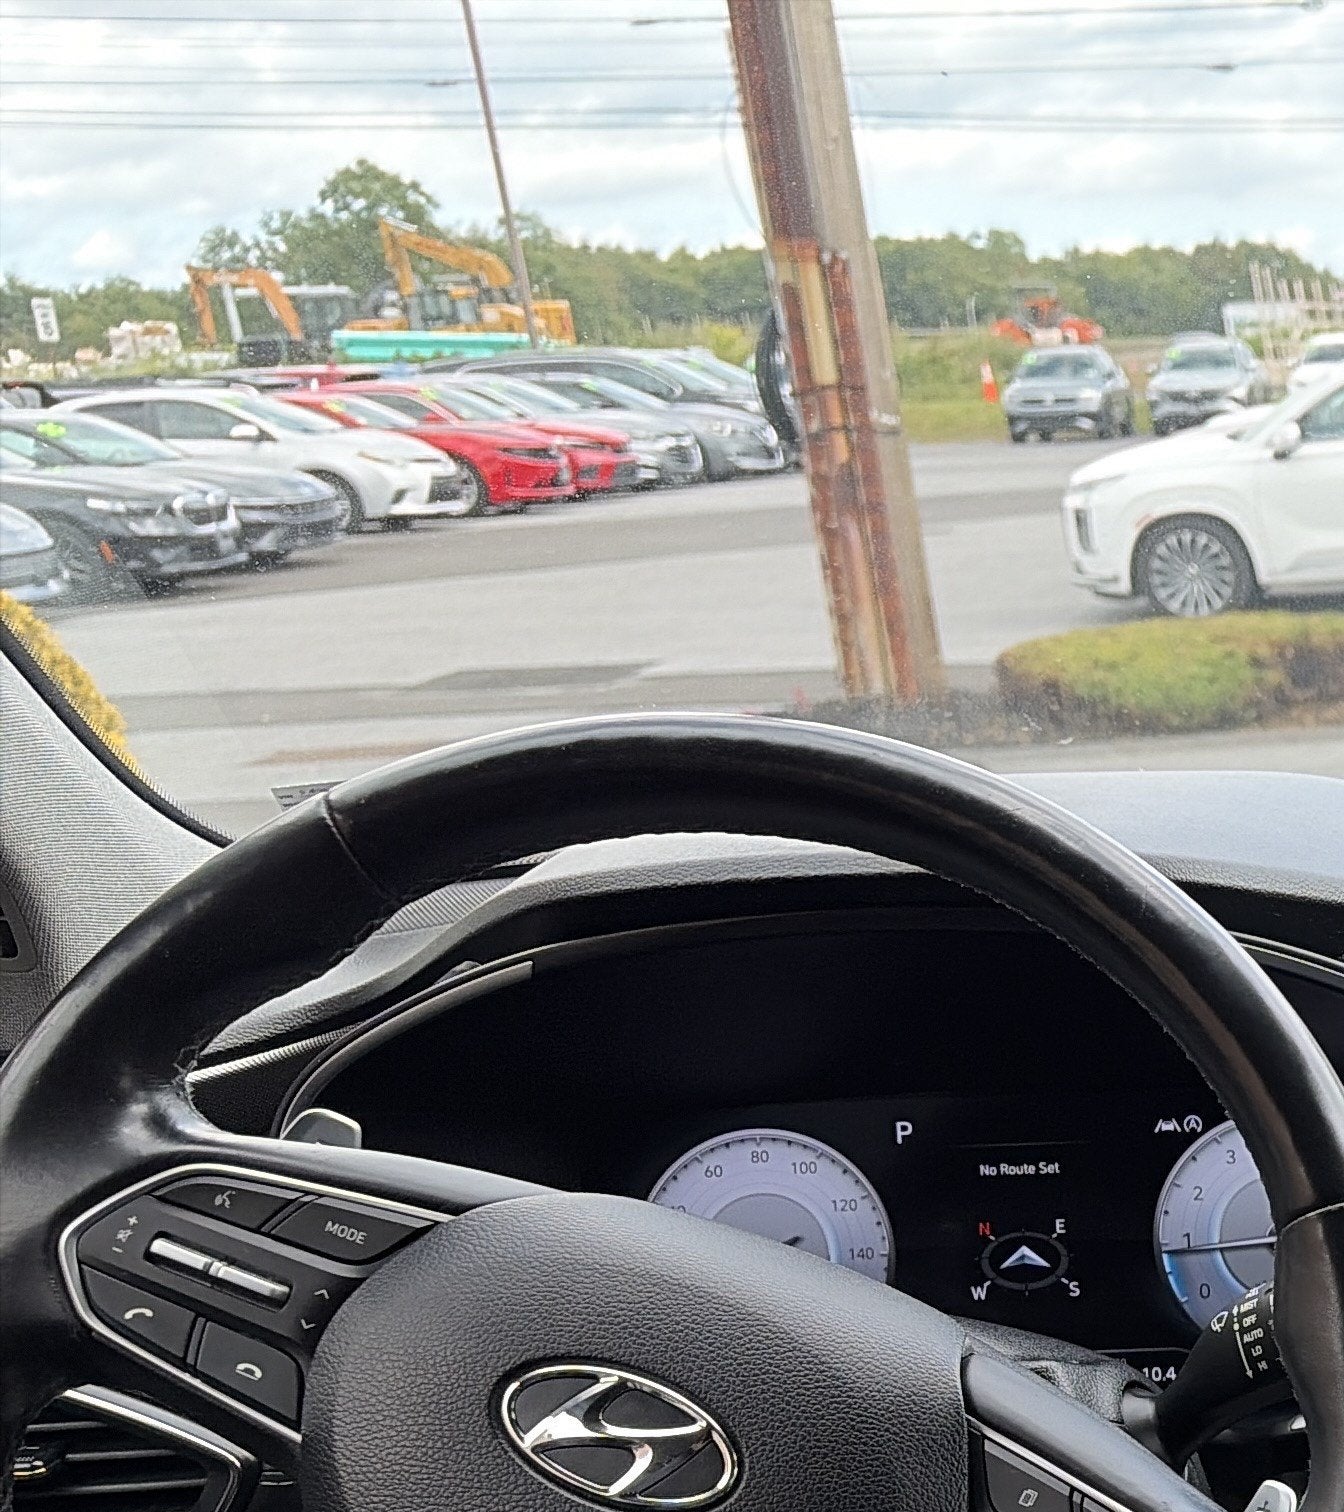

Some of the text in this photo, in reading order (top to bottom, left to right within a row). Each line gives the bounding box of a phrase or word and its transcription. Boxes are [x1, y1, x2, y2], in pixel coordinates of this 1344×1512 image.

[895, 1121, 913, 1145] P
[751, 1150, 769, 1163] 80
[1226, 1150, 1237, 1165] 3
[704, 1165, 723, 1178] 60
[791, 1161, 817, 1175] 100
[979, 1162, 1060, 1176] No Route Set
[1193, 1186, 1203, 1201] 2
[832, 1199, 857, 1212] 120
[324, 1221, 367, 1245] MODE
[979, 1222, 990, 1235] N
[1055, 1219, 1066, 1233] E
[1183, 1232, 1192, 1248] 1
[849, 1247, 874, 1260] 140
[970, 1286, 987, 1300] W
[1069, 1281, 1080, 1297] S
[1200, 1283, 1210, 1299] 0
[1242, 1314, 1257, 1327] OFF
[1243, 1328, 1264, 1343] AUTO
[1251, 1345, 1262, 1356] LO
